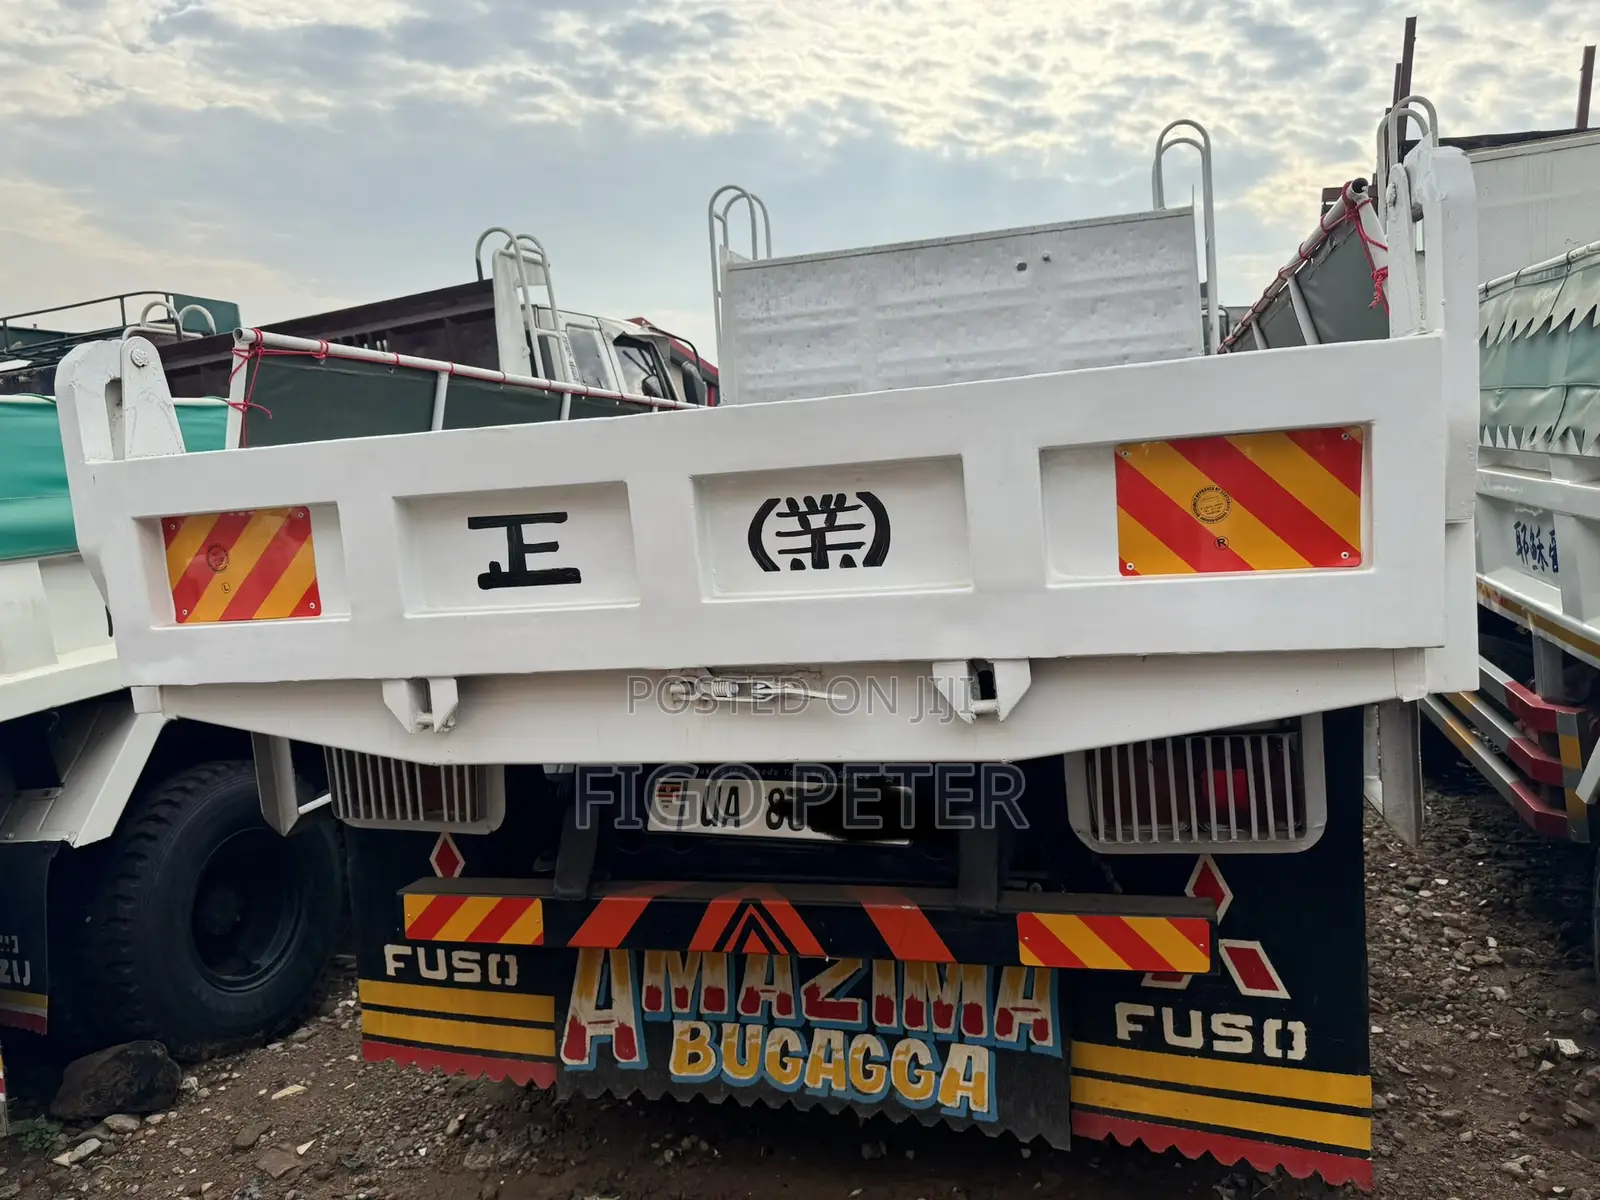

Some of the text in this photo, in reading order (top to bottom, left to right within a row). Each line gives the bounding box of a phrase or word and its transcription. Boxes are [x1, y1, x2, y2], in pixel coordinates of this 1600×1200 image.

[468, 511, 581, 590] 正
[384, 943, 518, 986] FUSO
[560, 948, 1060, 1068] AMAZIMA
[1115, 1001, 1307, 1060] FUSO
[668, 1019, 997, 1120] BUGAGGA
